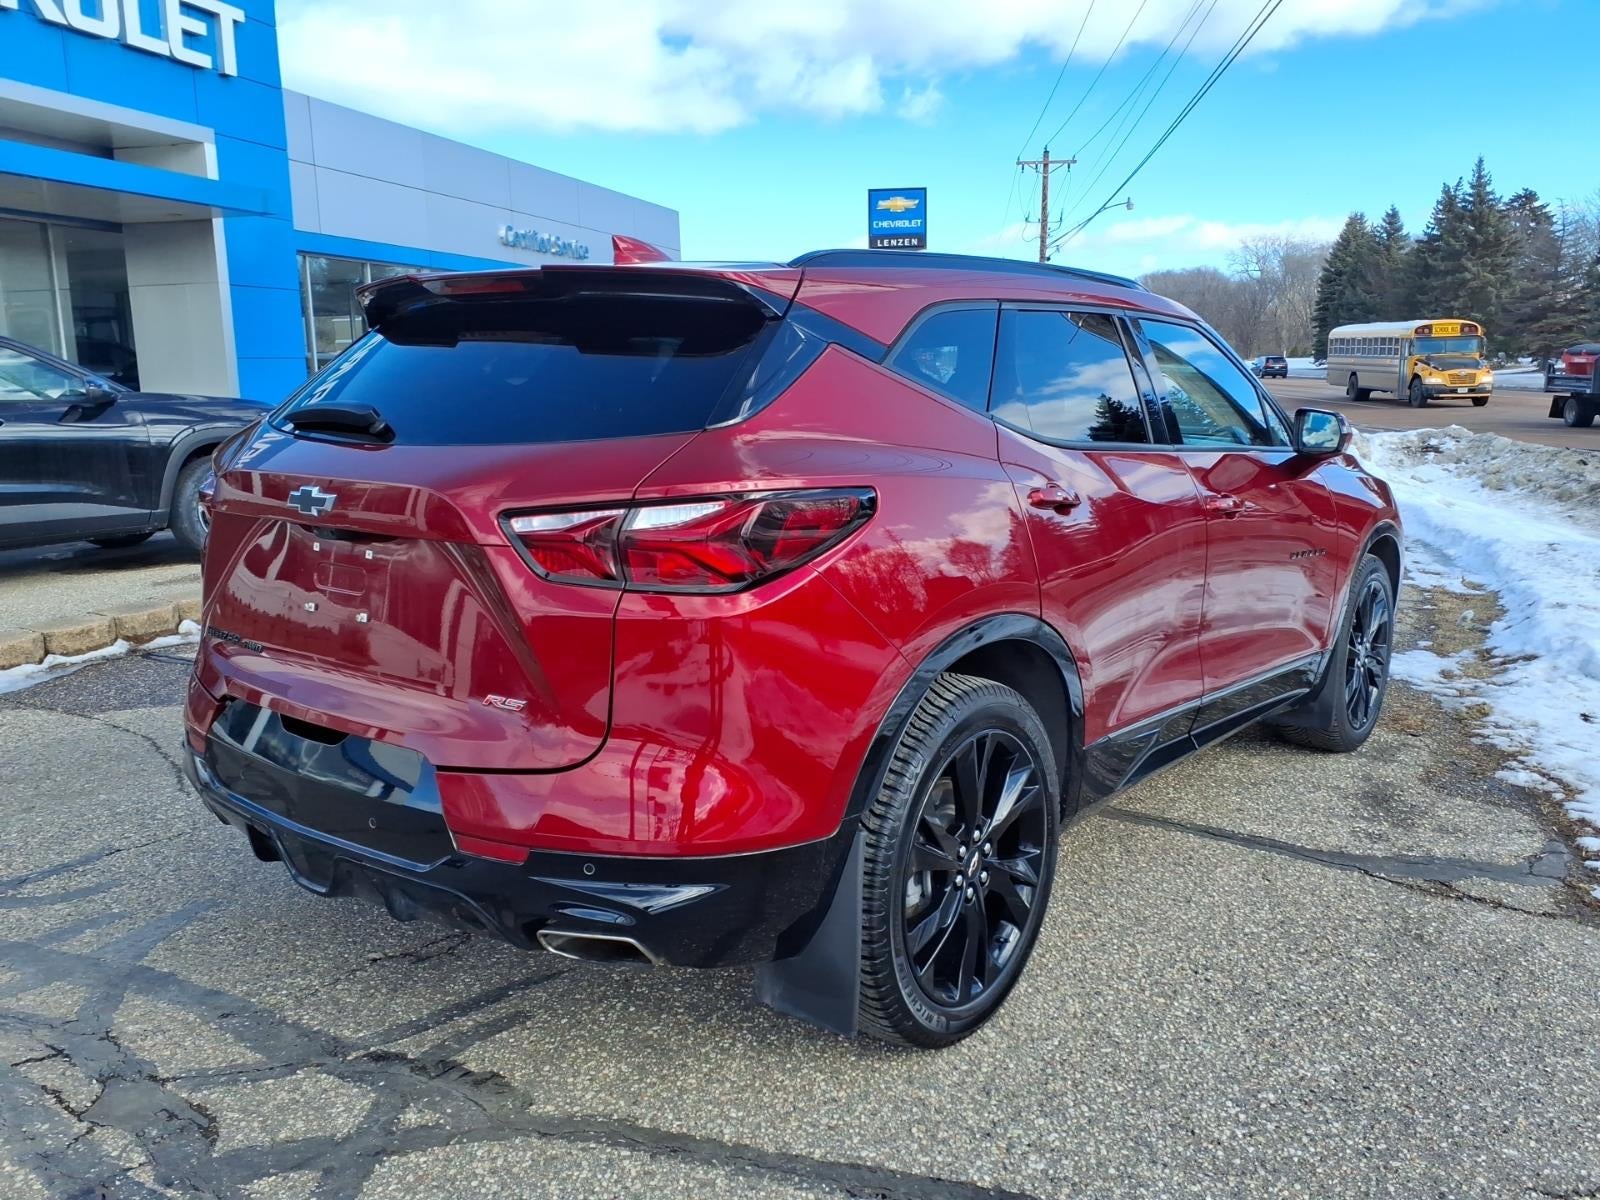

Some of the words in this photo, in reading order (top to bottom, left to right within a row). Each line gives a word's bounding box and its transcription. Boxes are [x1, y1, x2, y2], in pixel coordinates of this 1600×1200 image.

[0, 0, 245, 77] LET
[873, 219, 922, 229] CHEVROLET
[498, 225, 550, 254] Certified
[550, 235, 589, 260] Service
[877, 238, 918, 247] LENZEN
[481, 694, 528, 712] RS
